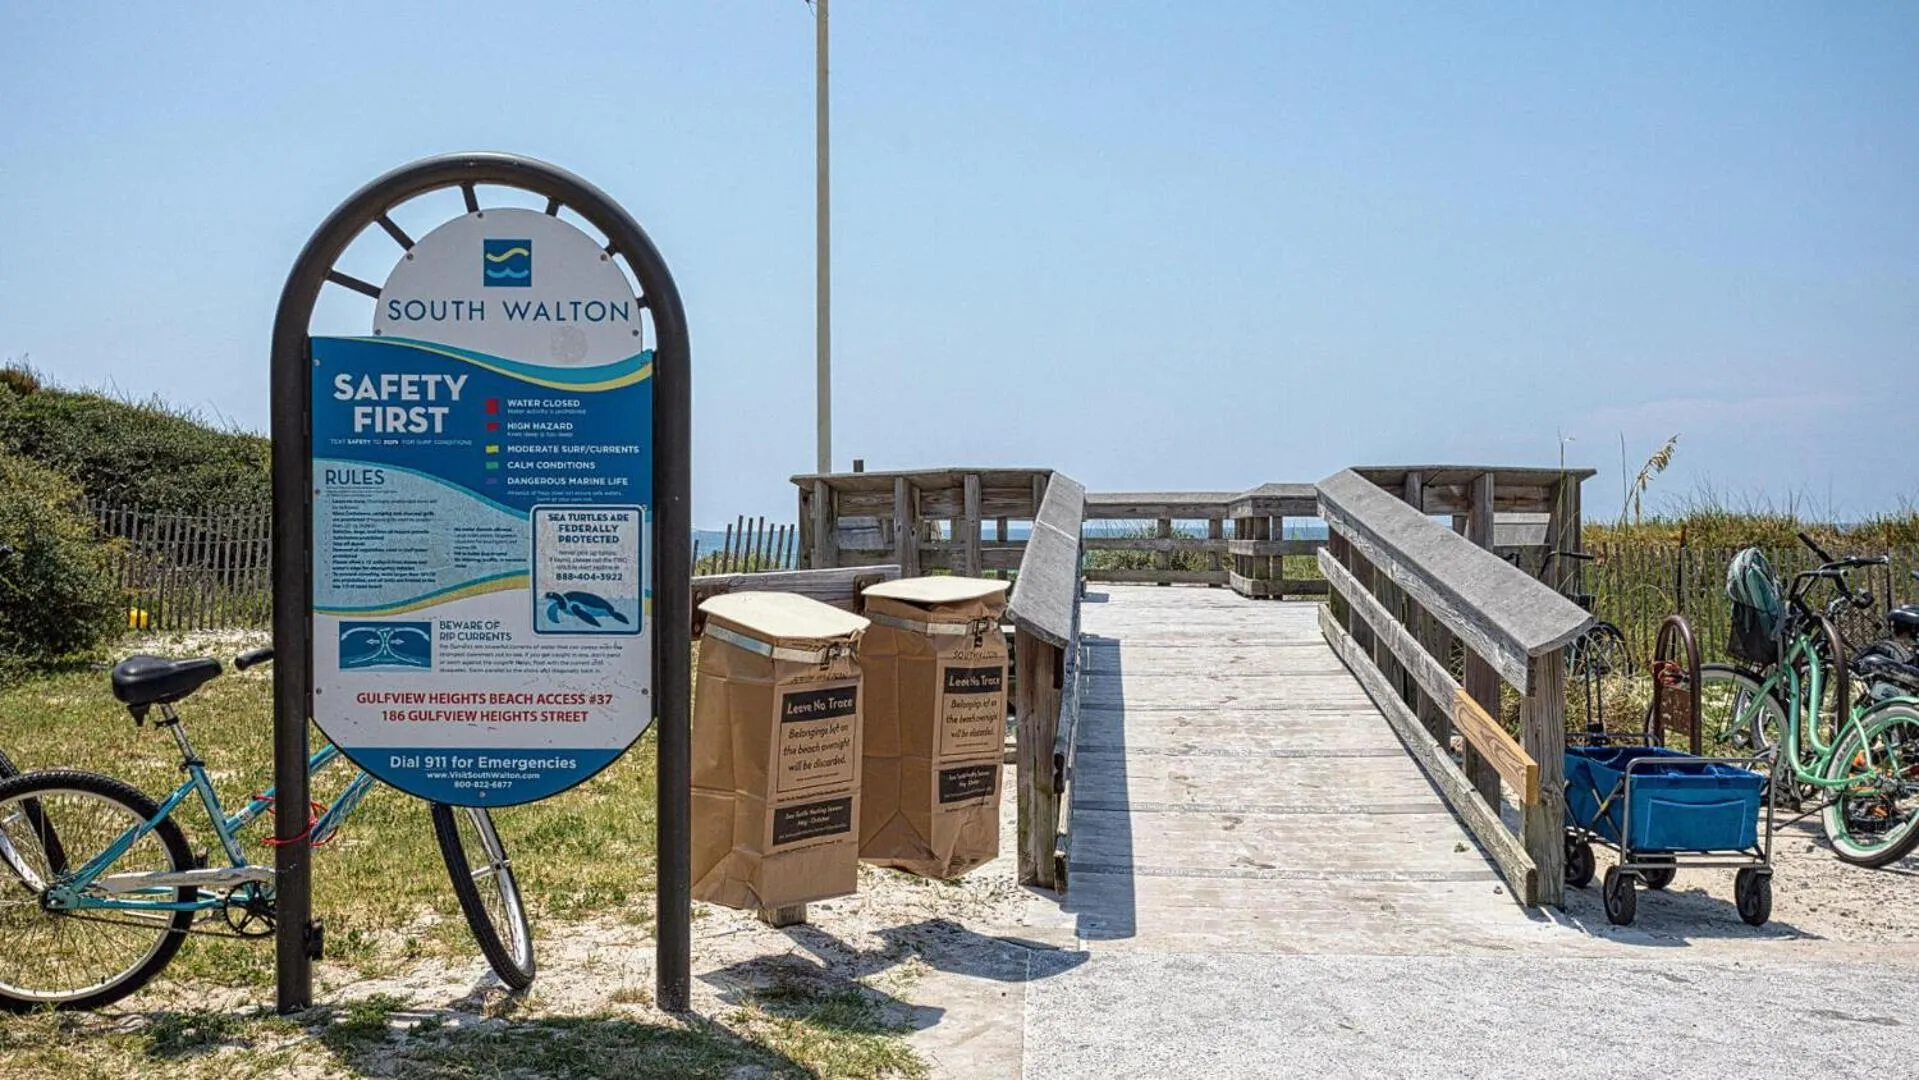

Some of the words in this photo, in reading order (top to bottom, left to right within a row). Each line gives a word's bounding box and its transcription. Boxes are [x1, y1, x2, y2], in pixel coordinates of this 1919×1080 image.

[388, 300, 485, 321] SOUTH
[502, 301, 629, 322] WALTON
[333, 373, 468, 400] SAFETY
[507, 399, 540, 408] WATER
[543, 399, 580, 408] CLOSED
[354, 406, 450, 433] FIRST
[507, 422, 530, 430] HIGH
[532, 422, 574, 430] HAZARD
[507, 445, 559, 453] MODERATE
[561, 445, 640, 454] SURF/CURRENTS
[507, 461, 534, 470] CALM
[536, 461, 596, 470] CONDITIONS
[325, 469, 385, 485] RULES
[507, 477, 566, 485] DANGEROUS
[568, 477, 605, 485] MARINE
[608, 477, 629, 485] LIFE
[548, 513, 566, 521] SEA
[568, 513, 608, 521] TURTLES
[610, 513, 629, 521] ARE
[559, 524, 619, 533] FEDERALLY
[558, 535, 620, 543] PROTECTED
[556, 573, 622, 581] 888-404-3922
[439, 621, 483, 630] BEWARE
[485, 621, 500, 630] OF
[440, 632, 455, 641] RIP
[457, 632, 512, 641] CURRENTS
[357, 692, 426, 704] GULFVIEW
[428, 693, 486, 704] HEIGHTS
[489, 693, 533, 704] BEACH
[536, 693, 586, 704] ACCESS
[589, 694, 613, 704] #37
[787, 702, 812, 715] Leave
[814, 699, 826, 711] No
[828, 697, 853, 710] Trace
[382, 710, 405, 721] 186
[408, 710, 477, 721] GULFVIEW
[480, 711, 537, 722] HEIGHTS
[540, 711, 589, 722] STREET
[946, 713, 957, 724] the
[788, 726, 828, 740] Belongings
[783, 744, 796, 756] the
[798, 742, 820, 754] beach
[821, 737, 850, 751] overnight
[390, 756, 420, 769] Dial
[424, 757, 447, 769] 911
[452, 756, 473, 769] for
[478, 756, 577, 771] Emergencies
[788, 760, 802, 771] will
[803, 759, 812, 771] be
[813, 755, 846, 769] discarded.
[427, 771, 540, 779] www.VisitSouthWalton.com
